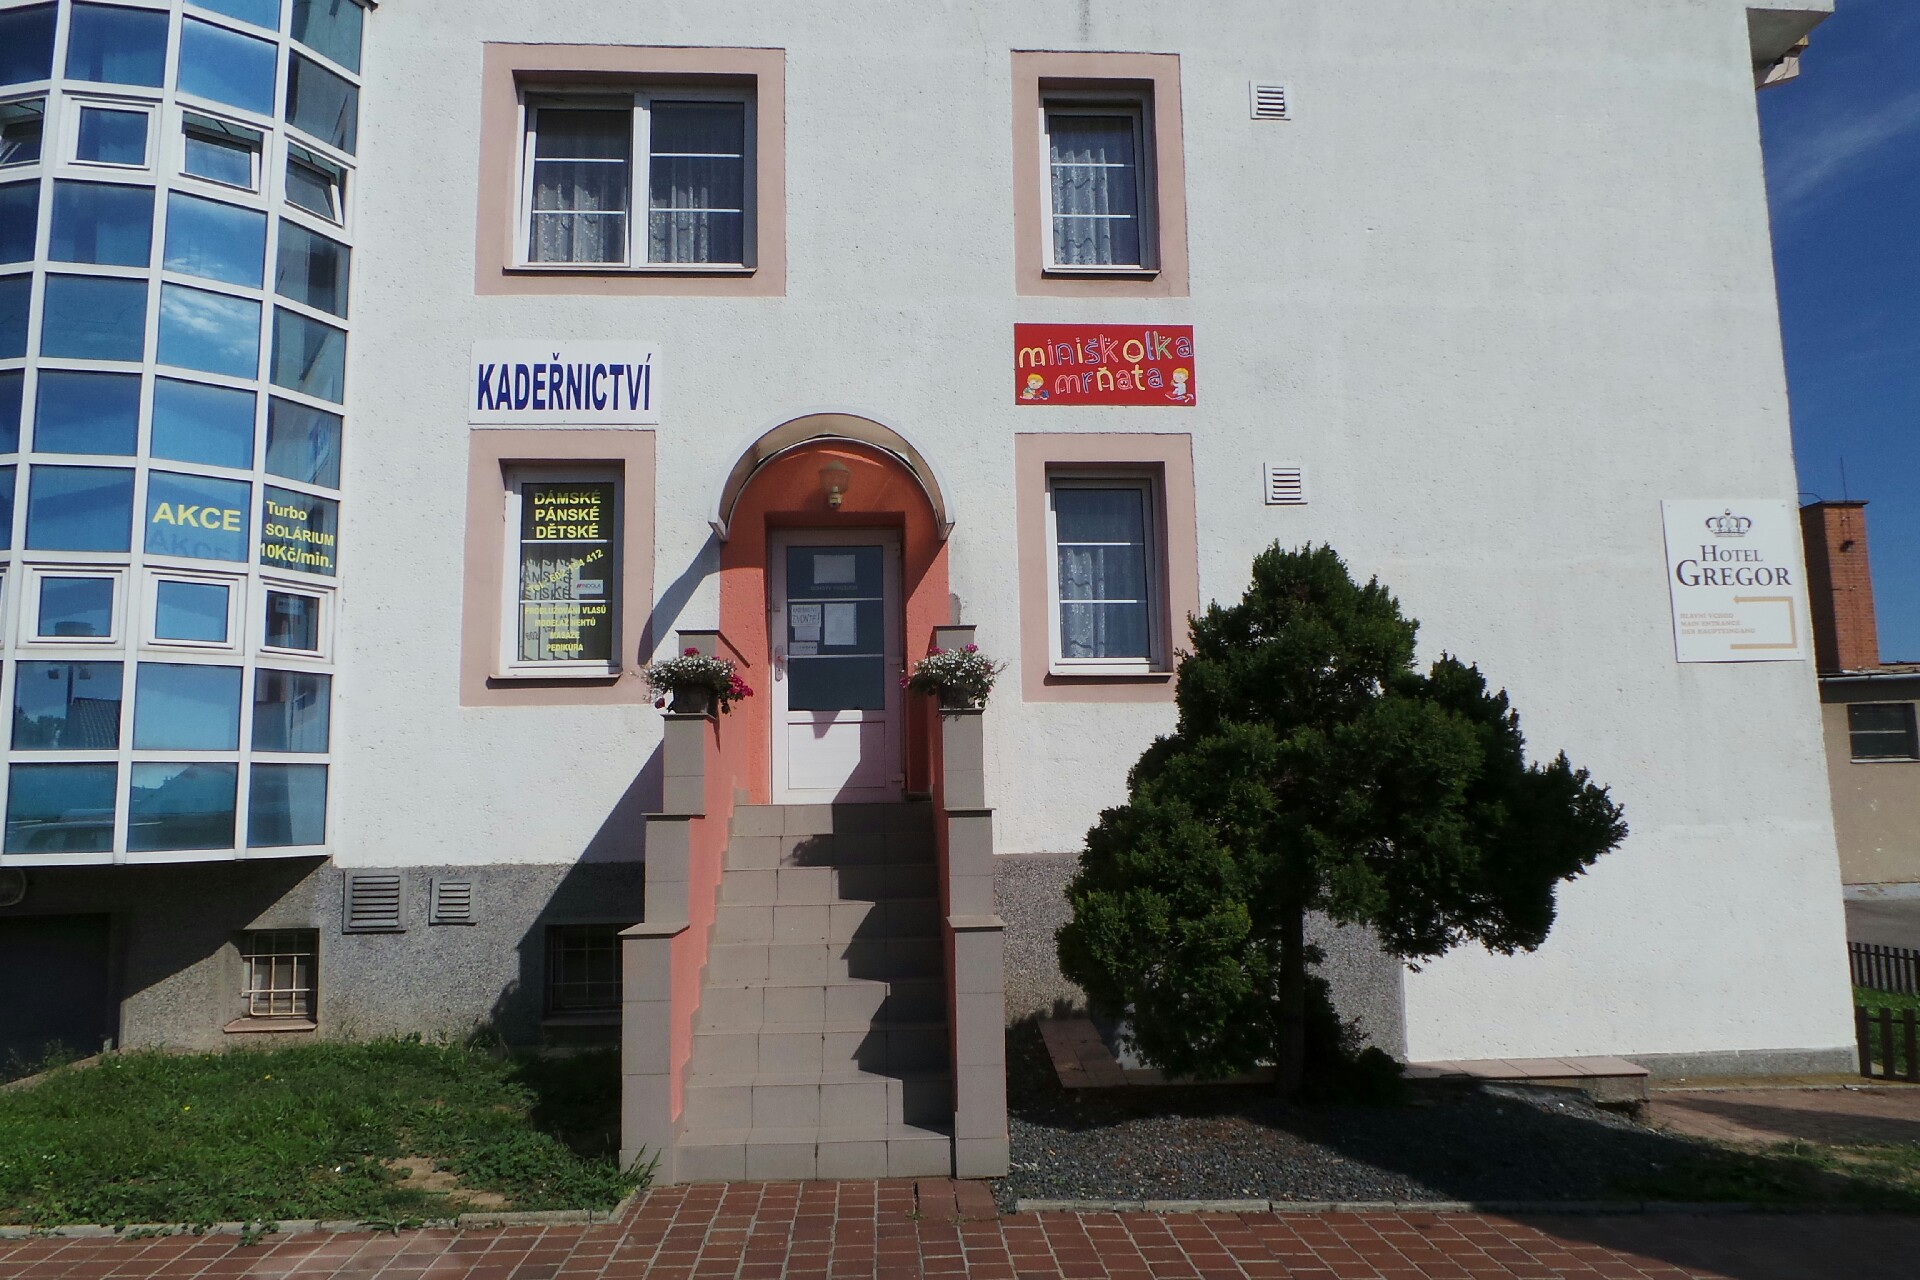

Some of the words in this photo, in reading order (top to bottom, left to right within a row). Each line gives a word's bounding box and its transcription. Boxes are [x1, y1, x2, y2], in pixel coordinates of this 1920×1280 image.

[1018, 331, 1193, 368] miniškolka
[477, 352, 652, 411] KADEŘNICTVÍ
[1055, 364, 1164, 394] mrňata
[534, 490, 601, 505] DÁMSKÉ
[152, 502, 241, 532] AKCE
[266, 500, 308, 521] Turbo
[535, 506, 600, 521] PÁNSKÉ
[265, 522, 335, 547] SOLÁRIUM
[535, 523, 599, 539] DĚTSKÉ
[585, 549, 604, 563] 412
